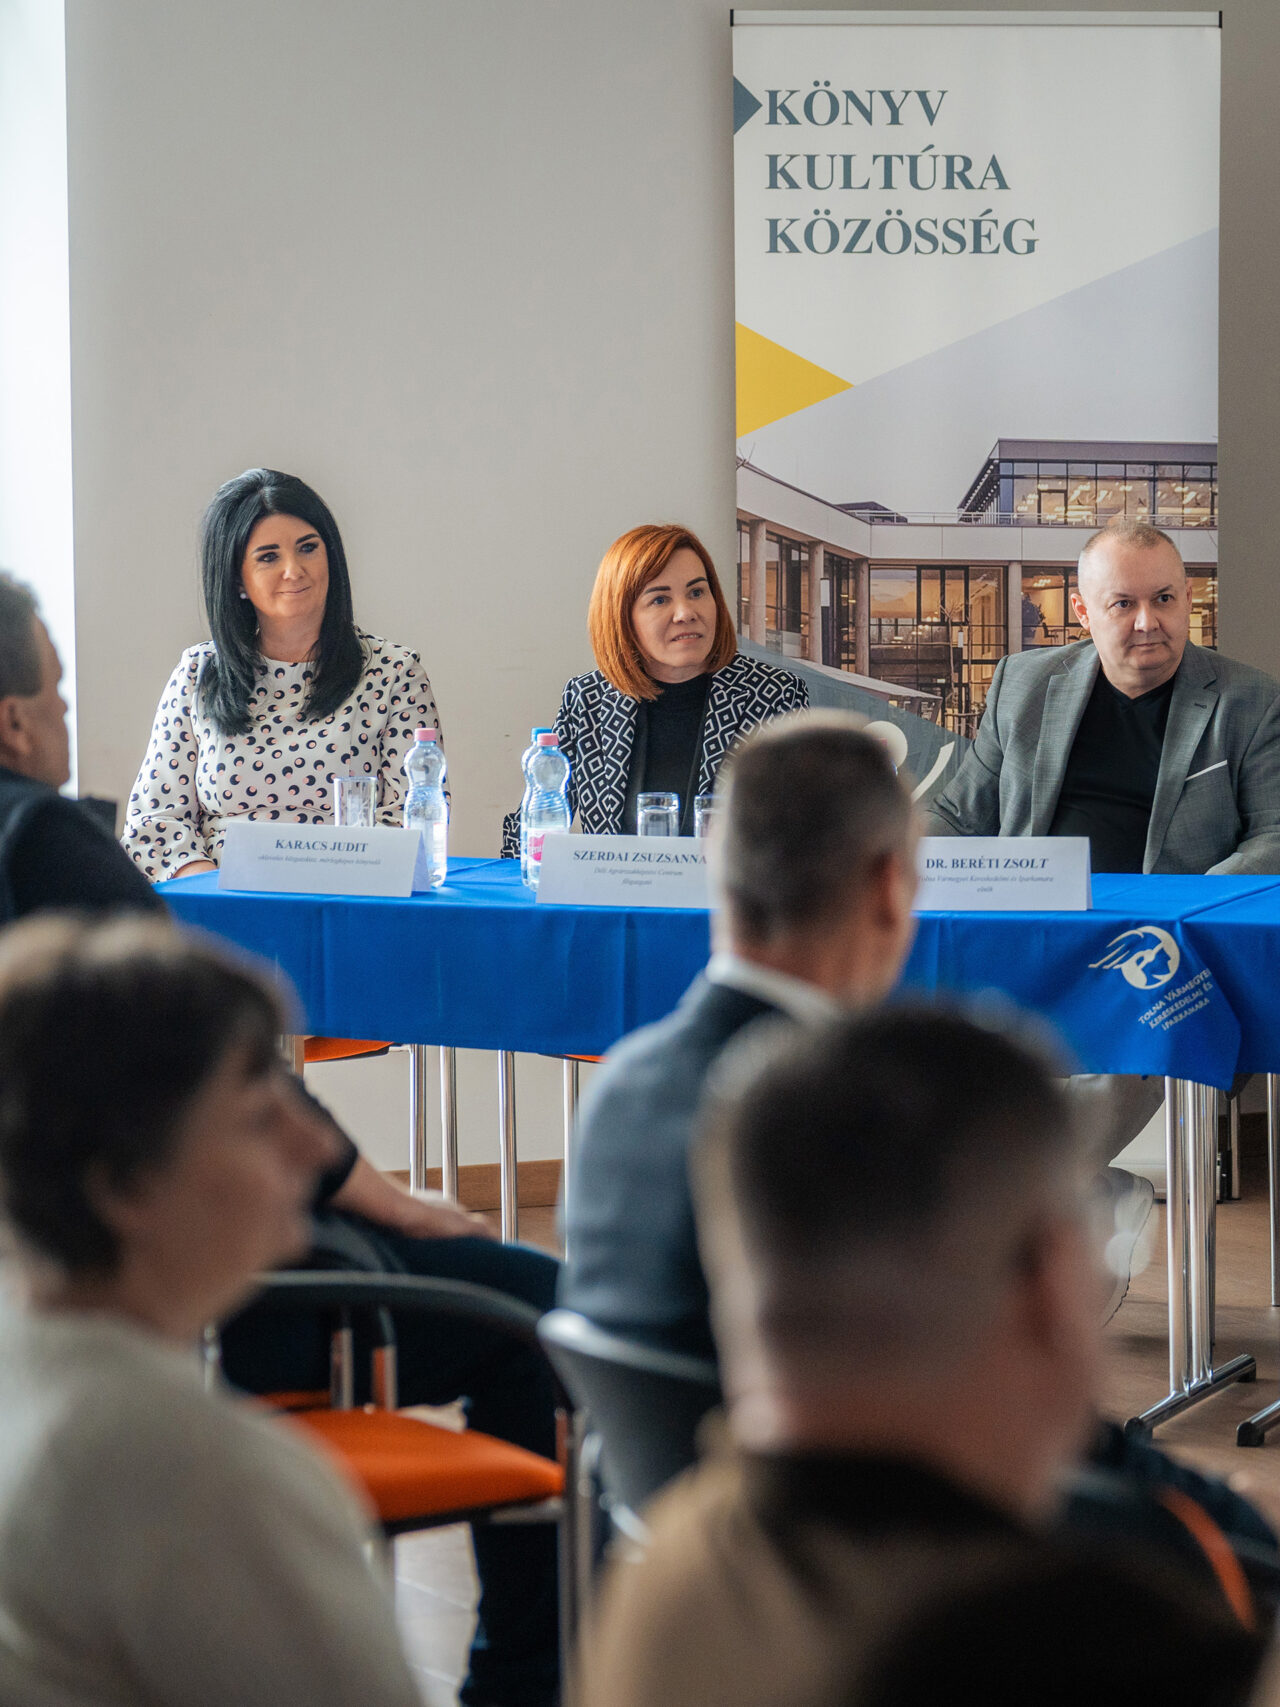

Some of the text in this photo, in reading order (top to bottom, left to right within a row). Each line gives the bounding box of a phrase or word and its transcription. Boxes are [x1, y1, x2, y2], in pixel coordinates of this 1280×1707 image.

[764, 80, 949, 127] KÖNYV
[764, 143, 1012, 191] KULTÚRA
[764, 208, 1040, 255] KÖZÖSSÉG
[275, 839, 369, 853] KARACS JUDIT
[573, 850, 629, 863] SZERDAI
[926, 855, 1050, 869] DR. BERÉTI ZSOLT
[1138, 1000, 1166, 1024] TOLNA
